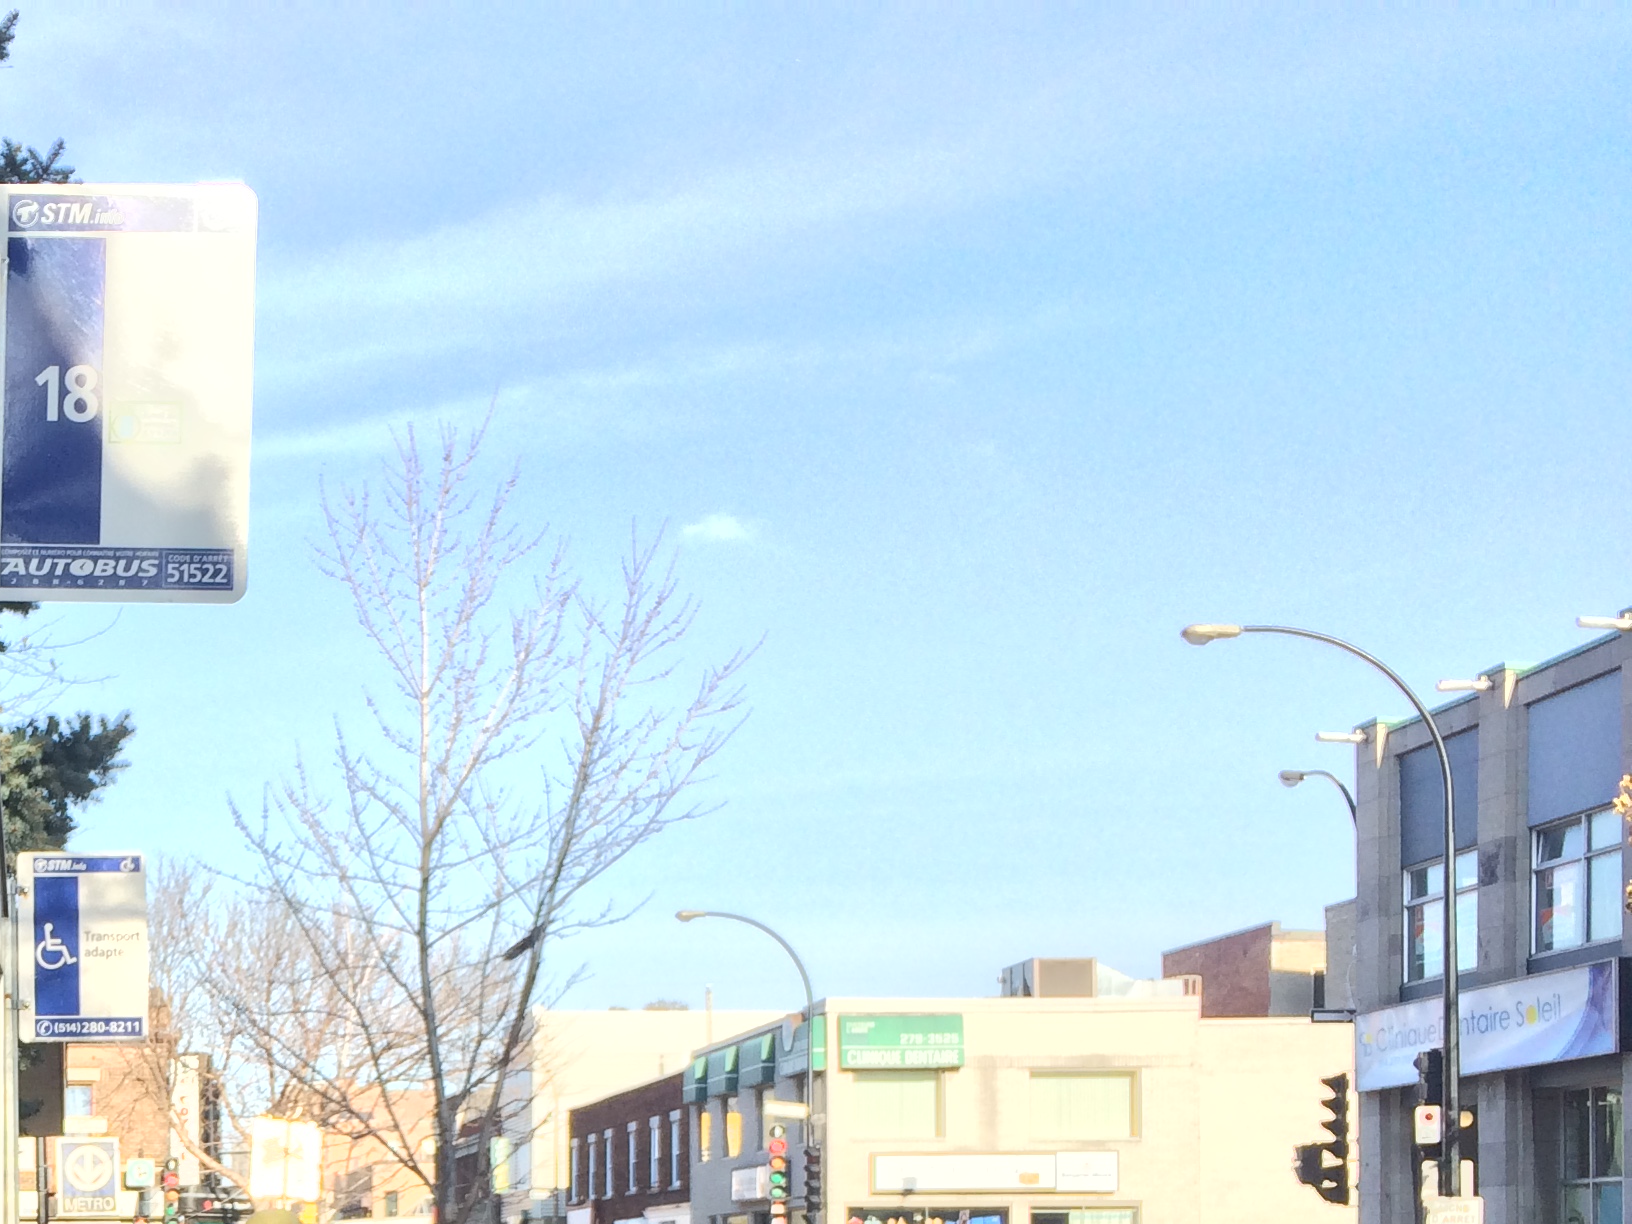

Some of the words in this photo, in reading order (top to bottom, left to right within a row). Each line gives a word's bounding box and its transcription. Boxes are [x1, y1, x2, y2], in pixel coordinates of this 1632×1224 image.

[34, 365, 99, 423] 18
[0, 557, 159, 577] AUTOBUS
[166, 562, 228, 584] 51522
[84, 930, 141, 944] Transport
[1438, 1006, 1511, 1041] Dntaire
[64, 1197, 115, 1210] METRO
